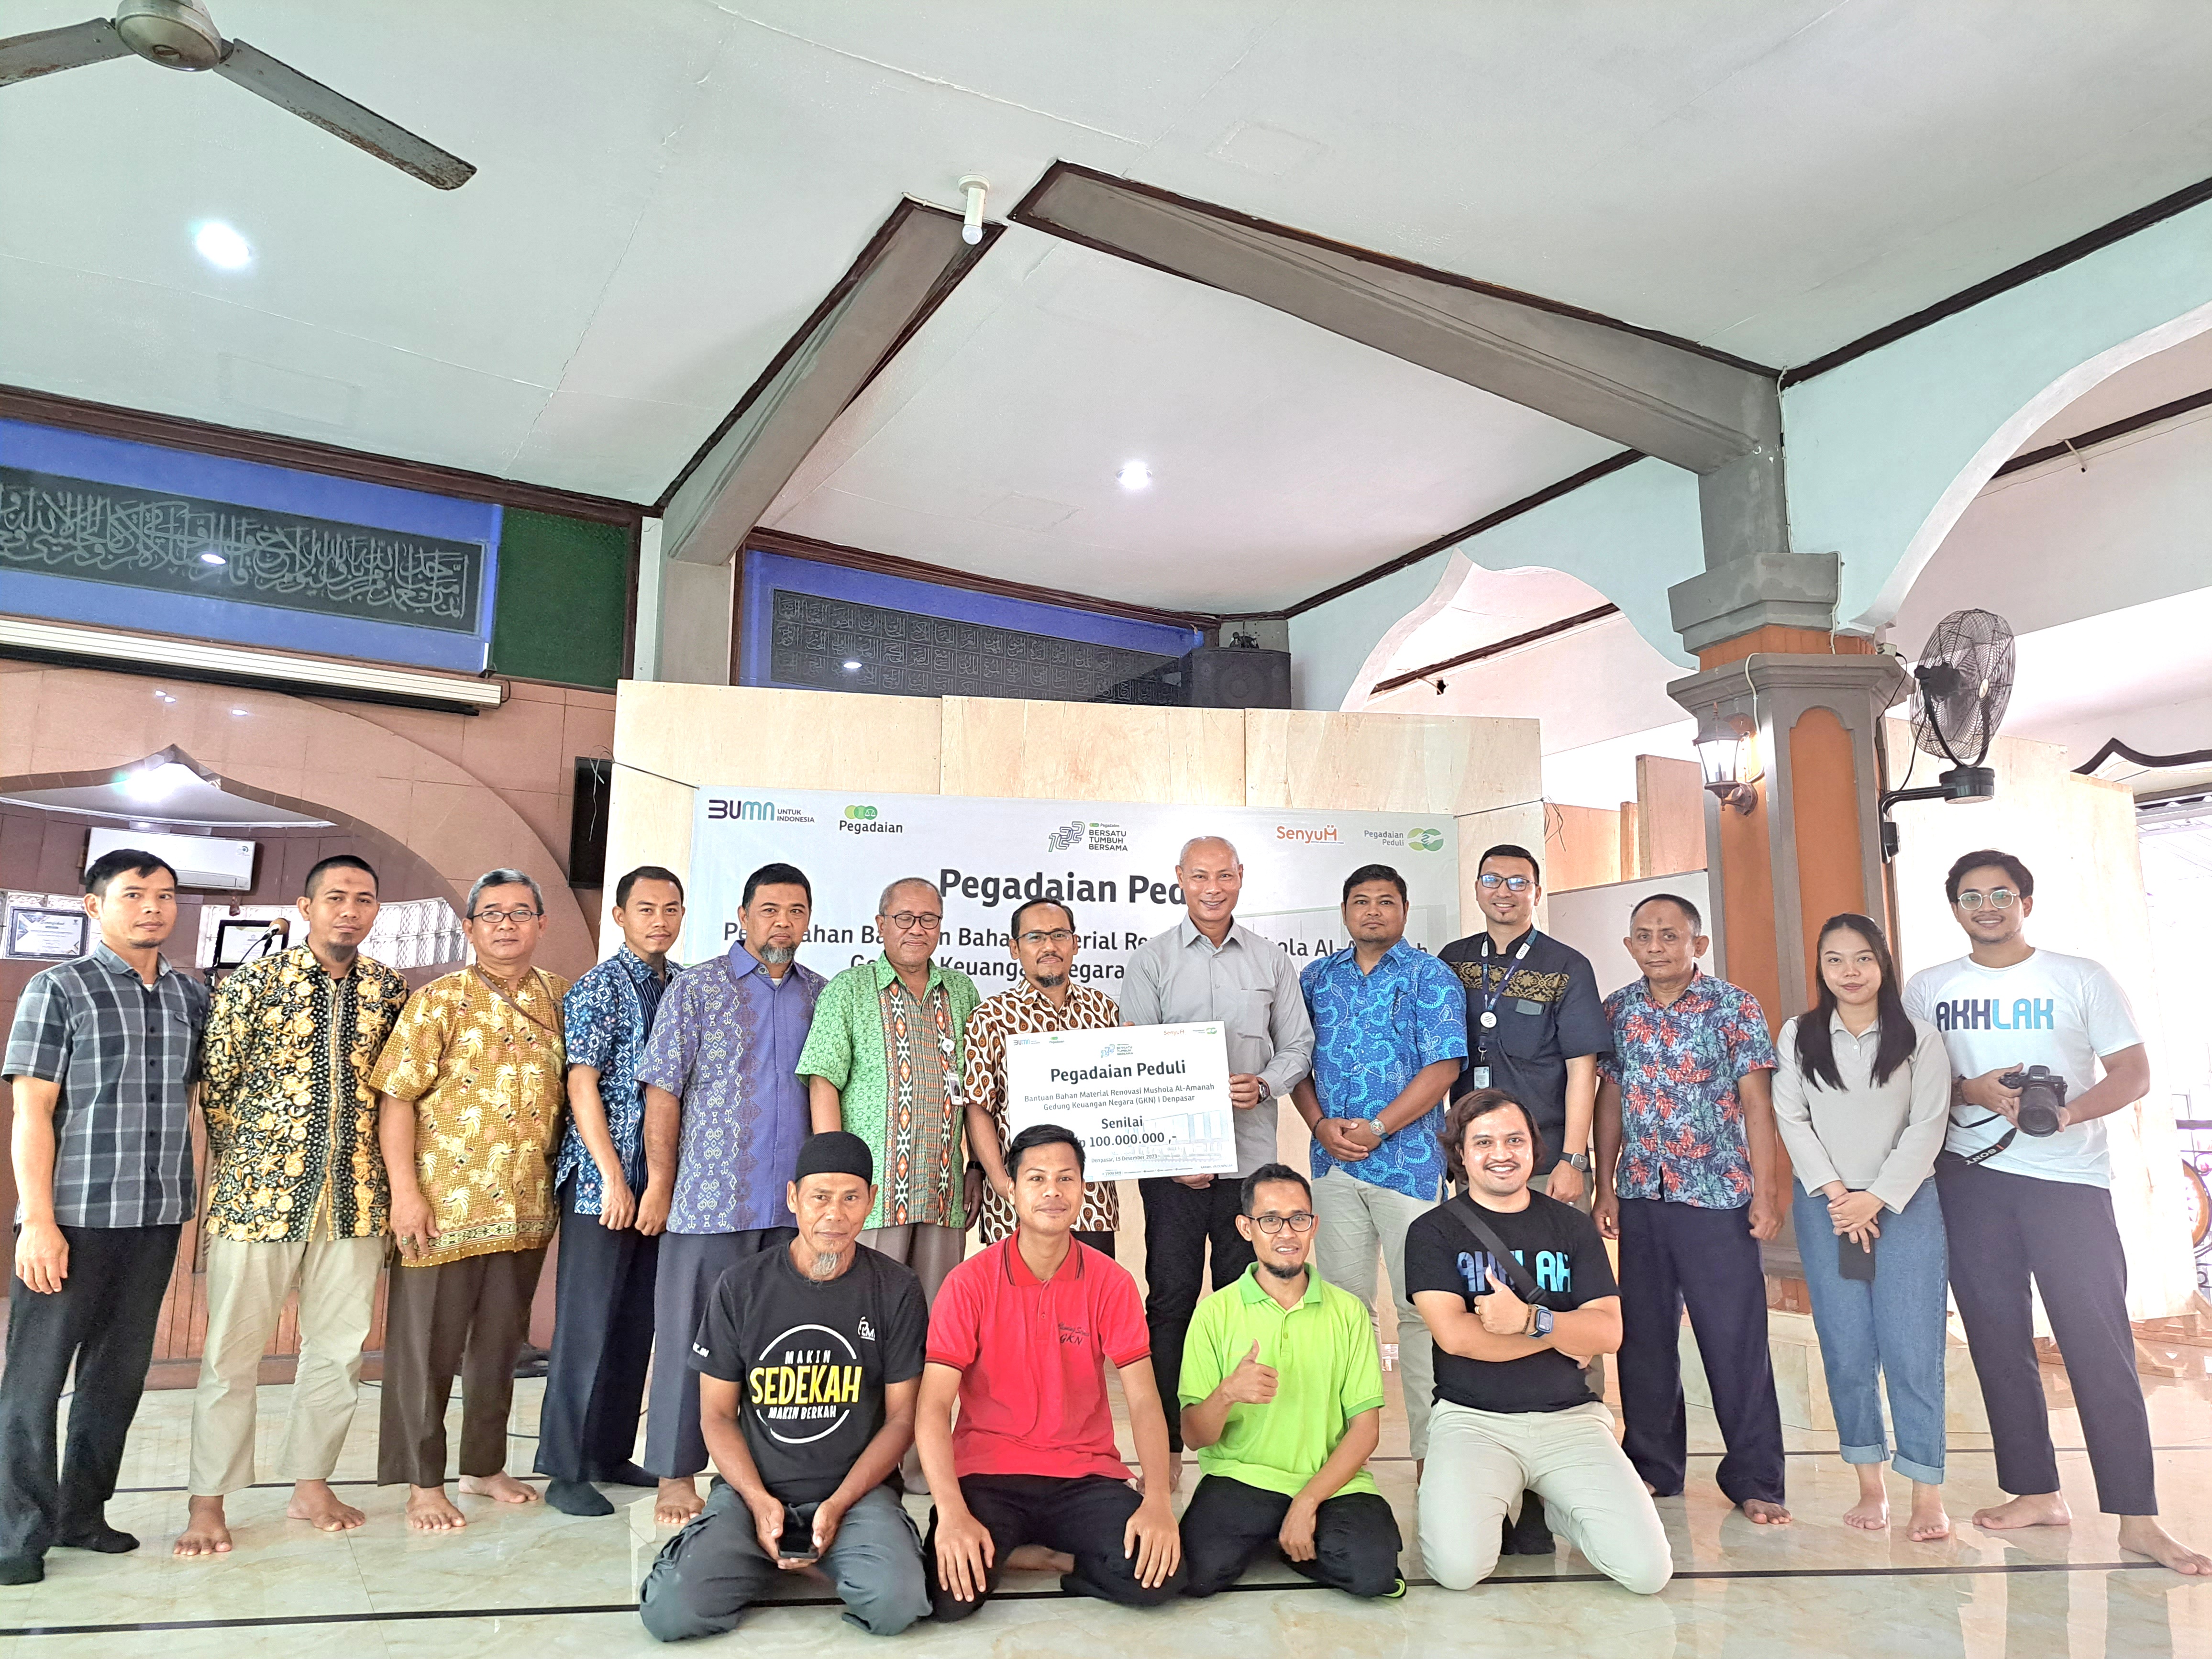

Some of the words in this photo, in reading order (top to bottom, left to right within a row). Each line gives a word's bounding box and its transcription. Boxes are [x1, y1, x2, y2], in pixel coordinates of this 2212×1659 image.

[839, 820, 903, 835] Pegadaian
[1364, 830, 1404, 839] Pegadaian
[1089, 843, 1128, 852] BERSAMA
[940, 869, 1117, 907] Pegadaian
[959, 928, 1010, 947] Baha
[1070, 963, 1124, 983] egara
[1936, 998, 2054, 1032] AKHLAK
[1051, 1064, 1132, 1084] Pegadaian
[1137, 1060, 1185, 1076] Peduli
[1080, 1090, 1109, 1098] Material
[1111, 1087, 1141, 1095] Renovasi
[1144, 1085, 1173, 1094] Mushola
[1175, 1083, 1215, 1092] Al-Amanah
[1109, 1099, 1134, 1107] Negara
[1136, 1096, 1156, 1105] (GKN)
[1162, 1095, 1195, 1103] Denpasar
[1101, 1116, 1143, 1129] Senilai
[1090, 1132, 1164, 1147] 100.000.000
[1965, 1148, 1997, 1165] SONY
[785, 1350, 831, 1364] MAKIN
[749, 1365, 863, 1405] SEDEKAH
[768, 1406, 799, 1419] MAKIN
[800, 1405, 836, 1419] BERKAH
